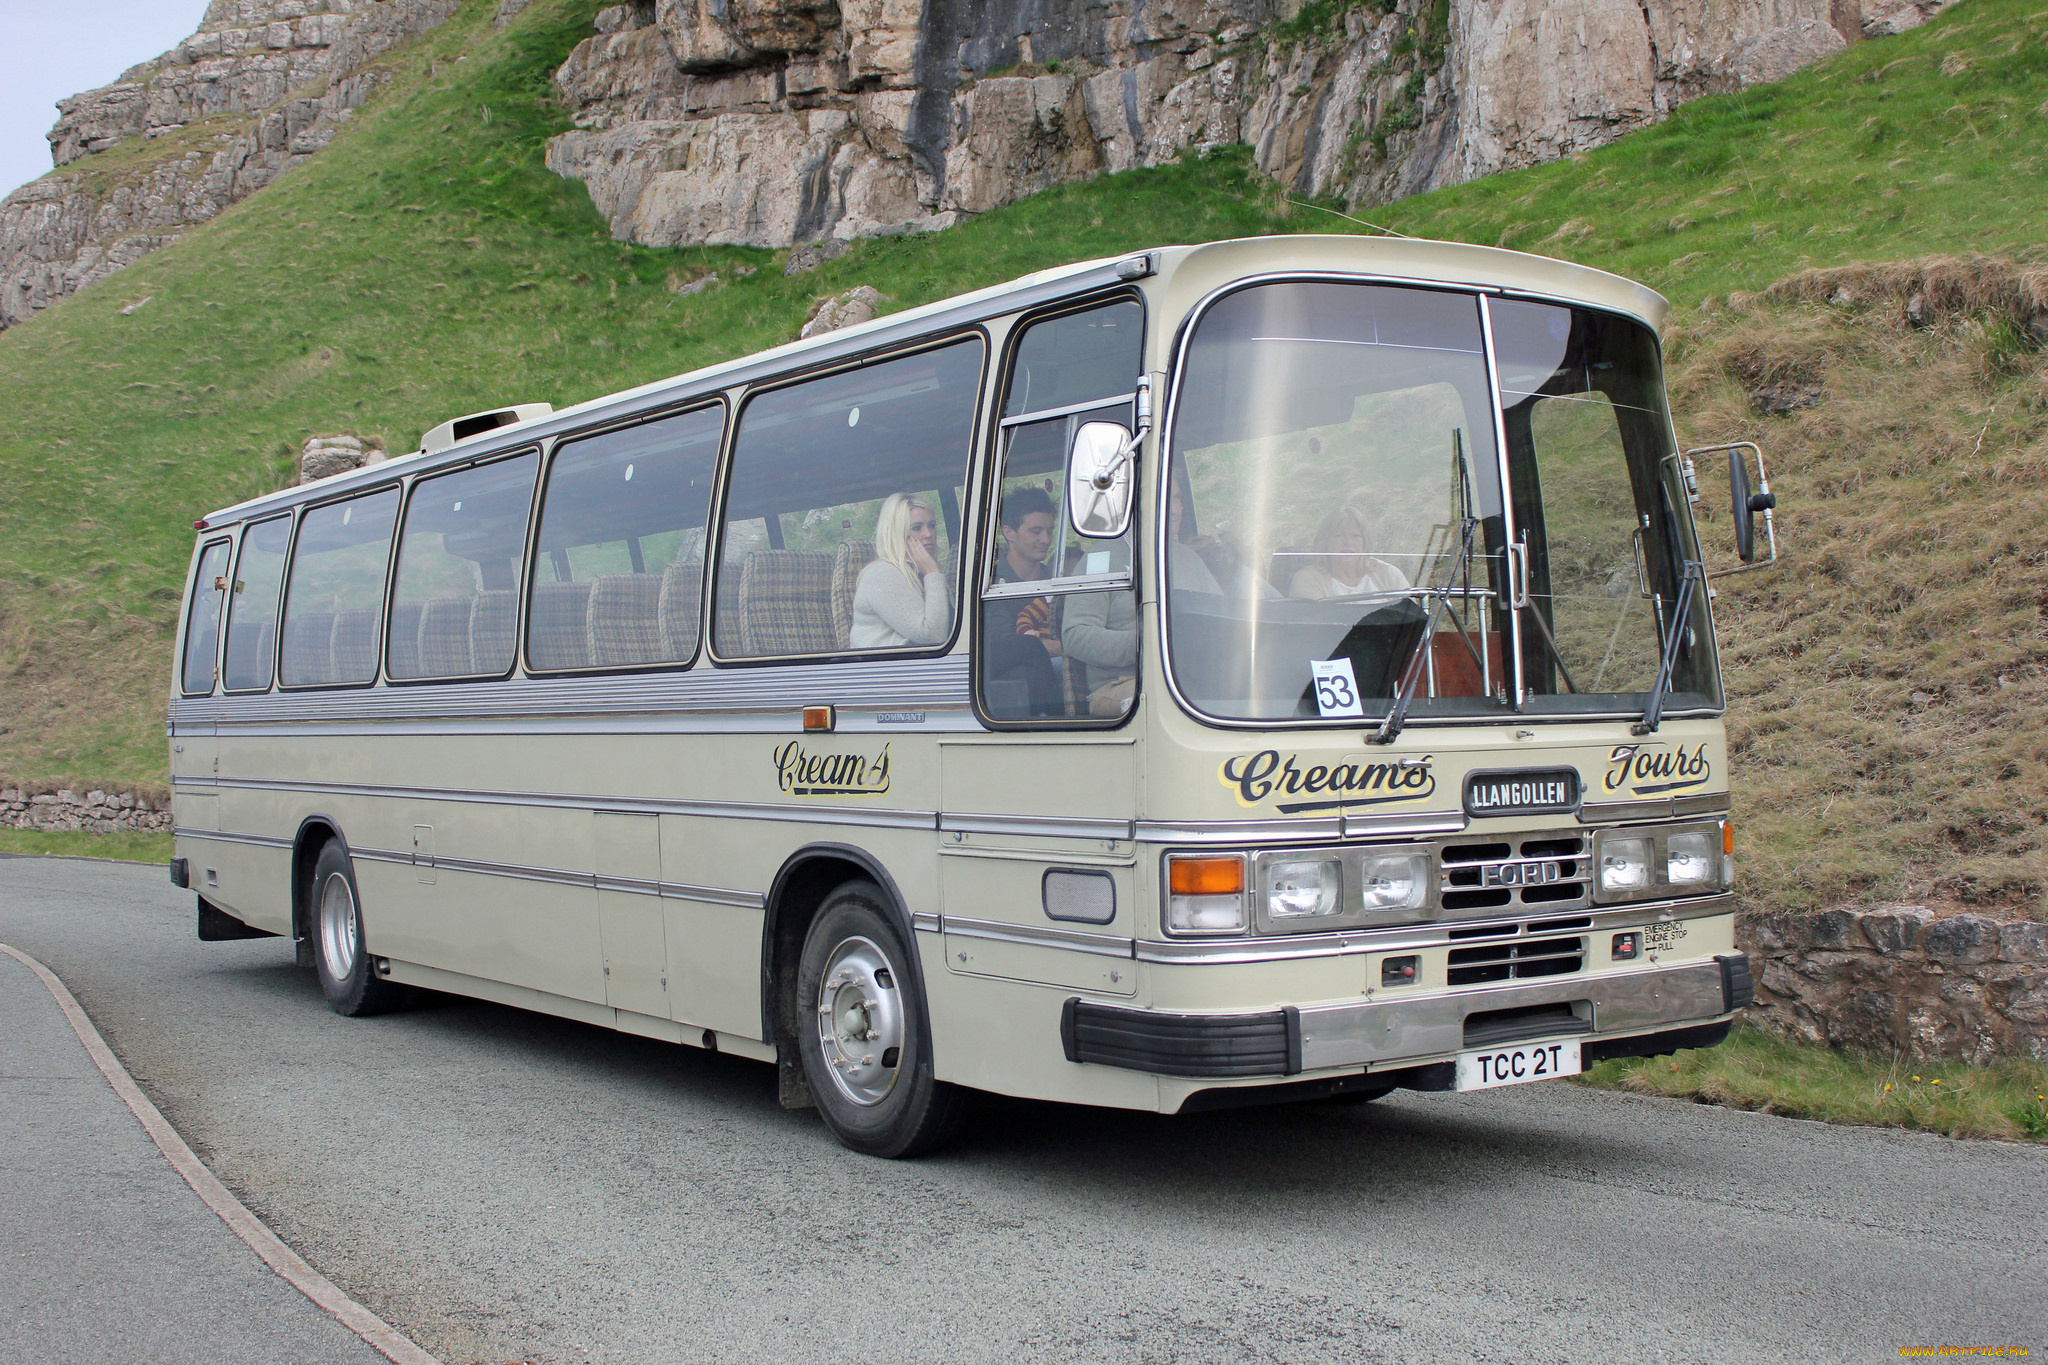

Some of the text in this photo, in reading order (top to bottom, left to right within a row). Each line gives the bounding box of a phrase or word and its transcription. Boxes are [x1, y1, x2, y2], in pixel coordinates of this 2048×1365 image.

[1316, 675, 1355, 710] 53
[878, 712, 923, 722] DOMINANT
[1220, 743, 1710, 804] Creams Tours
[1473, 781, 1566, 807] LLANGOLLEN
[1480, 861, 1562, 888] FORD
[1644, 922, 1684, 934] EMERGENCY
[1645, 929, 1688, 943] ENGINE STOP
[1658, 942, 1674, 951] PULL
[1477, 1045, 1562, 1083] TCC 2T
